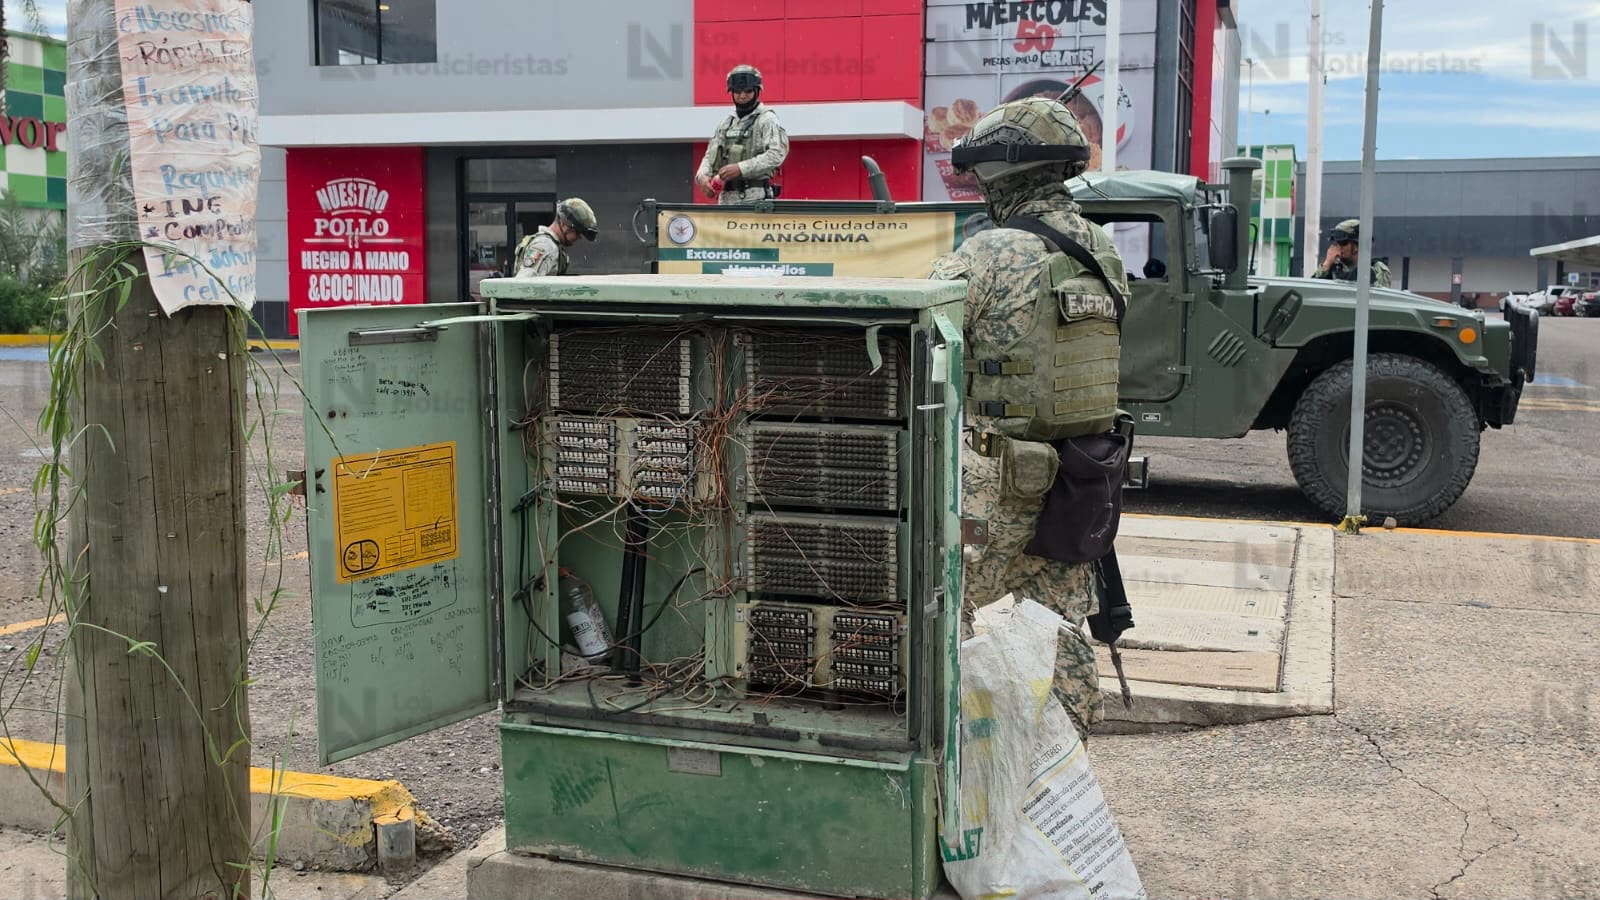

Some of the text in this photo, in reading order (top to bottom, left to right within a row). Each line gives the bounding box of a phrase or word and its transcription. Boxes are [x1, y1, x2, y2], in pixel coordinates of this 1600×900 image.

[161, 196, 221, 218] INE
[315, 182, 390, 213] NUESTRO
[314, 218, 390, 236] POLLO
[727, 219, 909, 231] Denuncia Ciudadana
[761, 231, 870, 243] ANÓNIMA
[301, 250, 410, 271] HECHO A MANO
[686, 248, 751, 260] Extorsión
[1067, 293, 1118, 318] EJERCI
